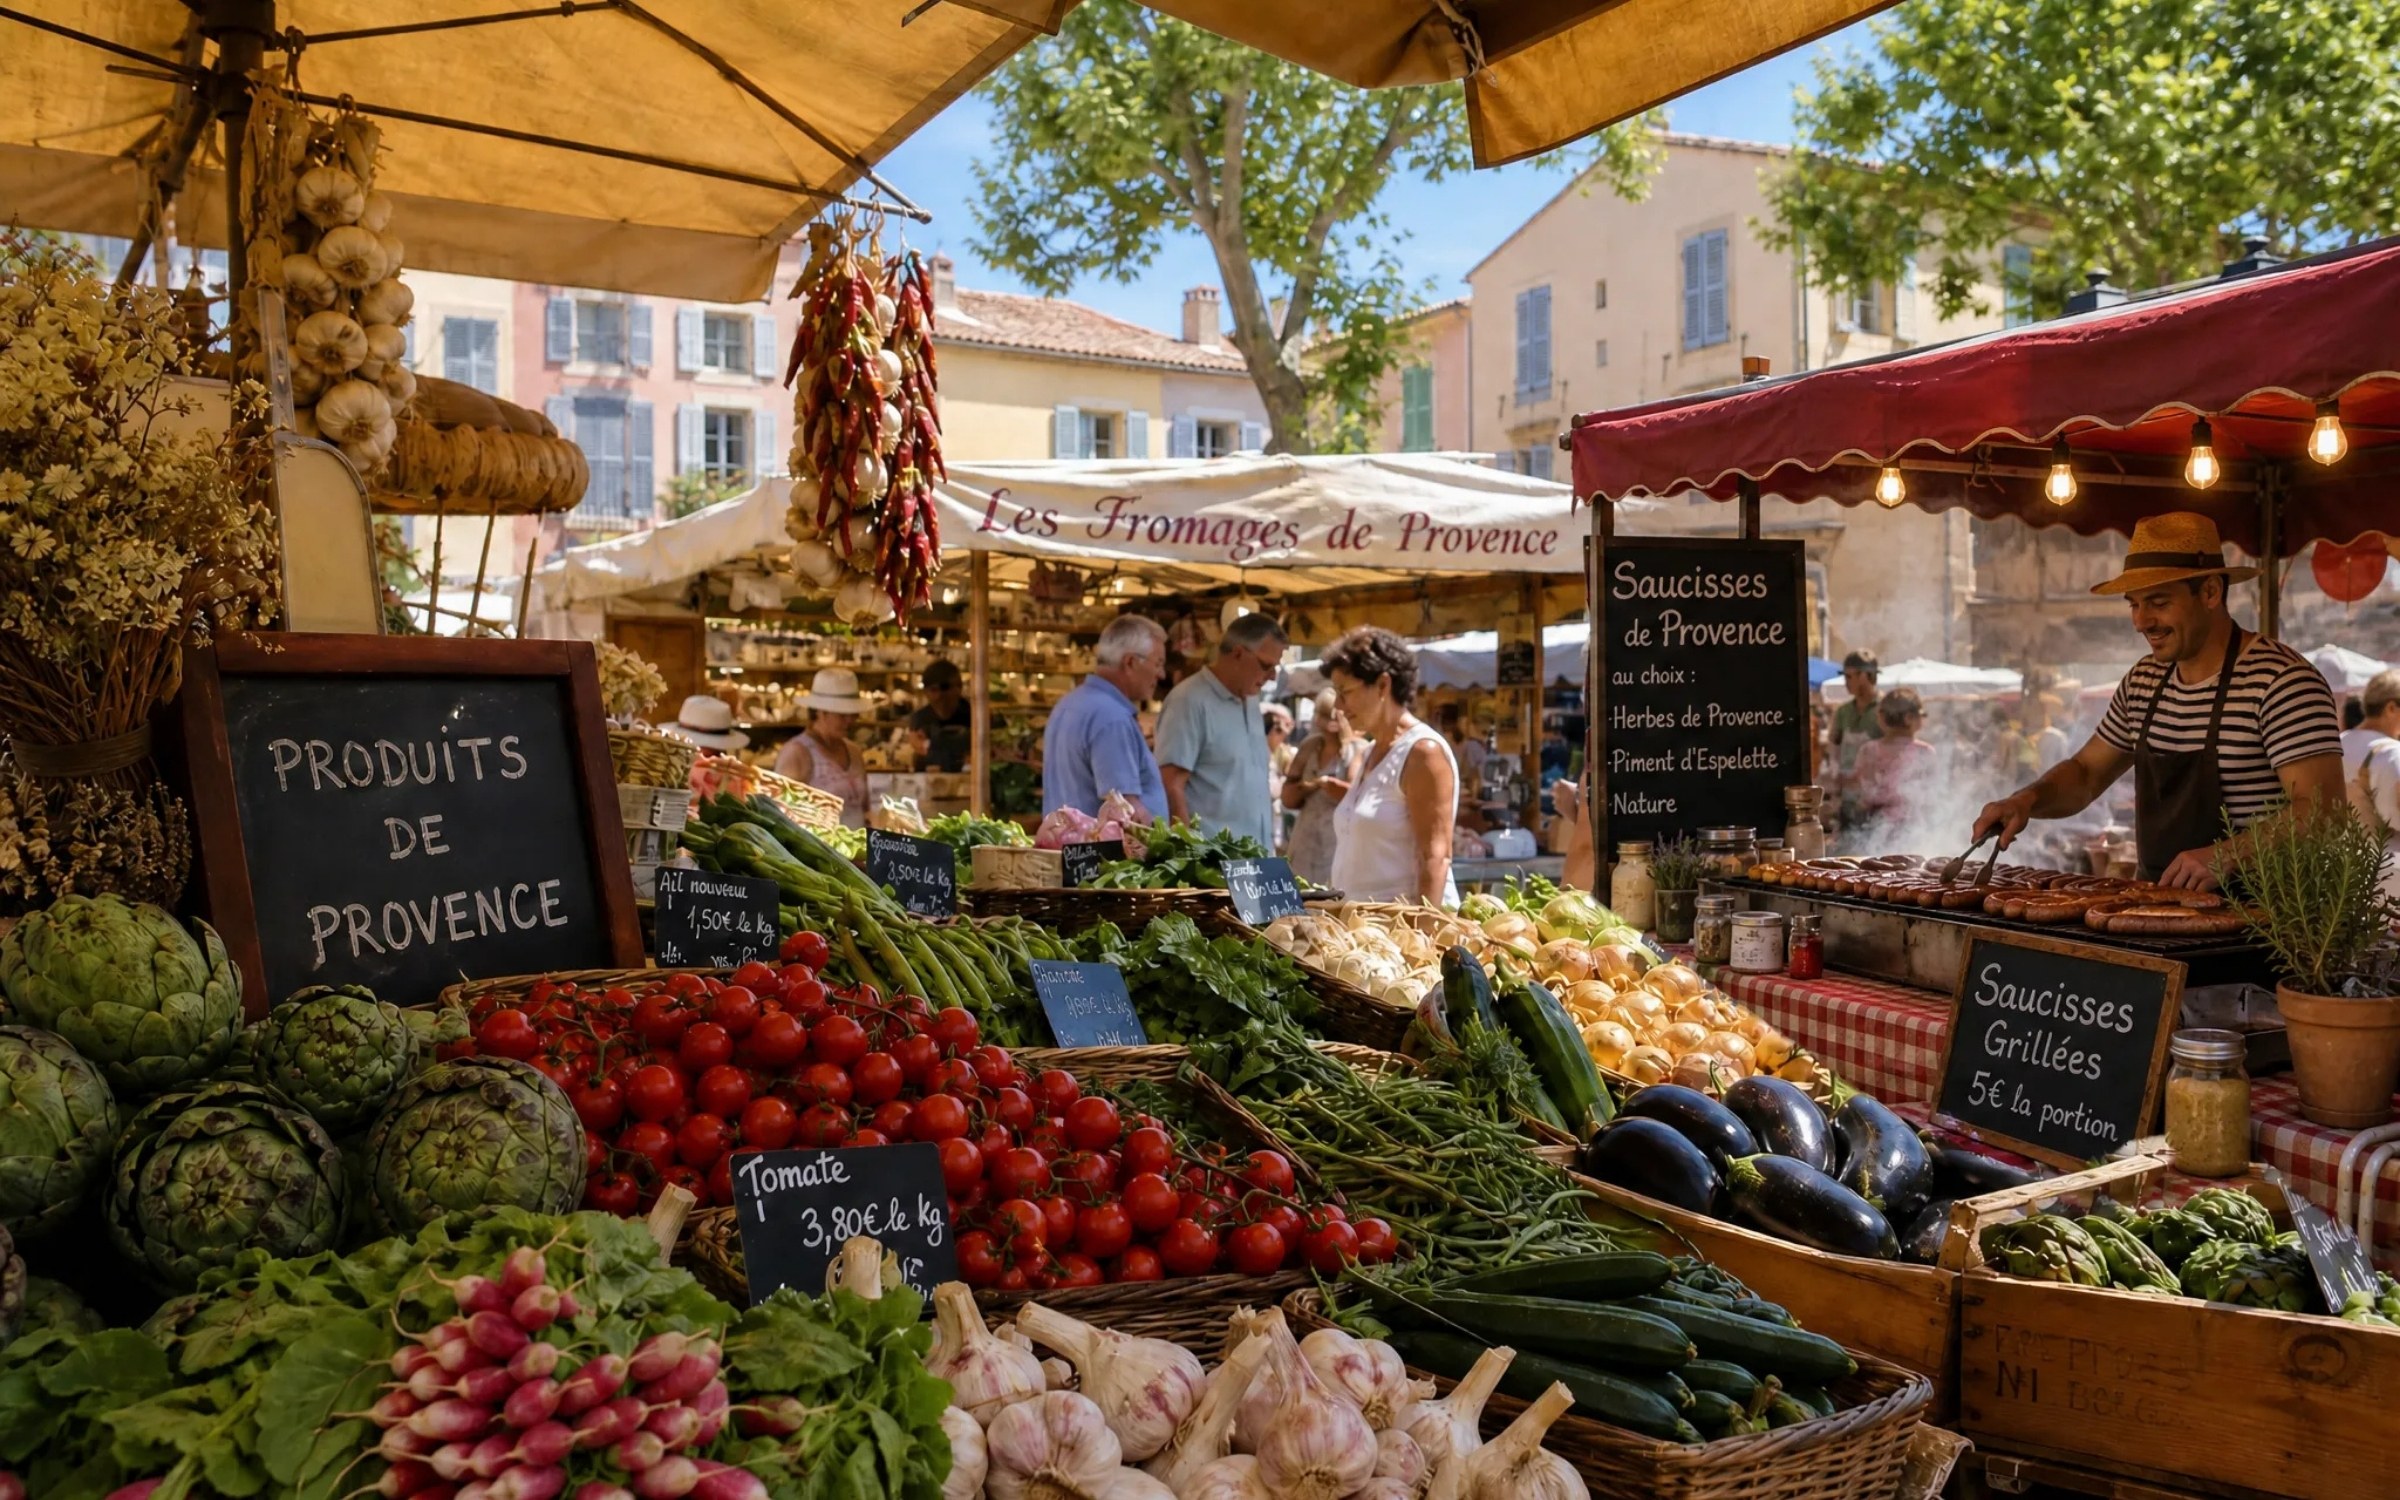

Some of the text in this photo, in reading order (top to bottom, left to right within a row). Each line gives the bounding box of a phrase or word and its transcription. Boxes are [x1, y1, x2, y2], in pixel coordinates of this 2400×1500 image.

[976, 488, 1559, 562] Les Fromages de Provence
[1613, 560, 1768, 600] Saucisses
[1624, 609, 1786, 647] de Provence
[1612, 671, 1634, 685] au
[1641, 664, 1685, 684] choix
[1613, 703, 1784, 729] Herbes de Provence
[1613, 746, 1779, 779] Piment d'Espelette
[1613, 791, 1678, 815] Nature
[384, 814, 450, 860] DE
[307, 878, 569, 970] PROVENCE
[687, 905, 733, 940] 1,50€
[735, 911, 752, 933] le
[1974, 962, 2134, 1034] Saucisses
[1984, 1019, 2102, 1080] Grillées
[1967, 1070, 2118, 1143] 5€ la portion
[738, 1151, 851, 1197] Tomate
[801, 1203, 883, 1256] 3,80€
[884, 1197, 911, 1233] le
